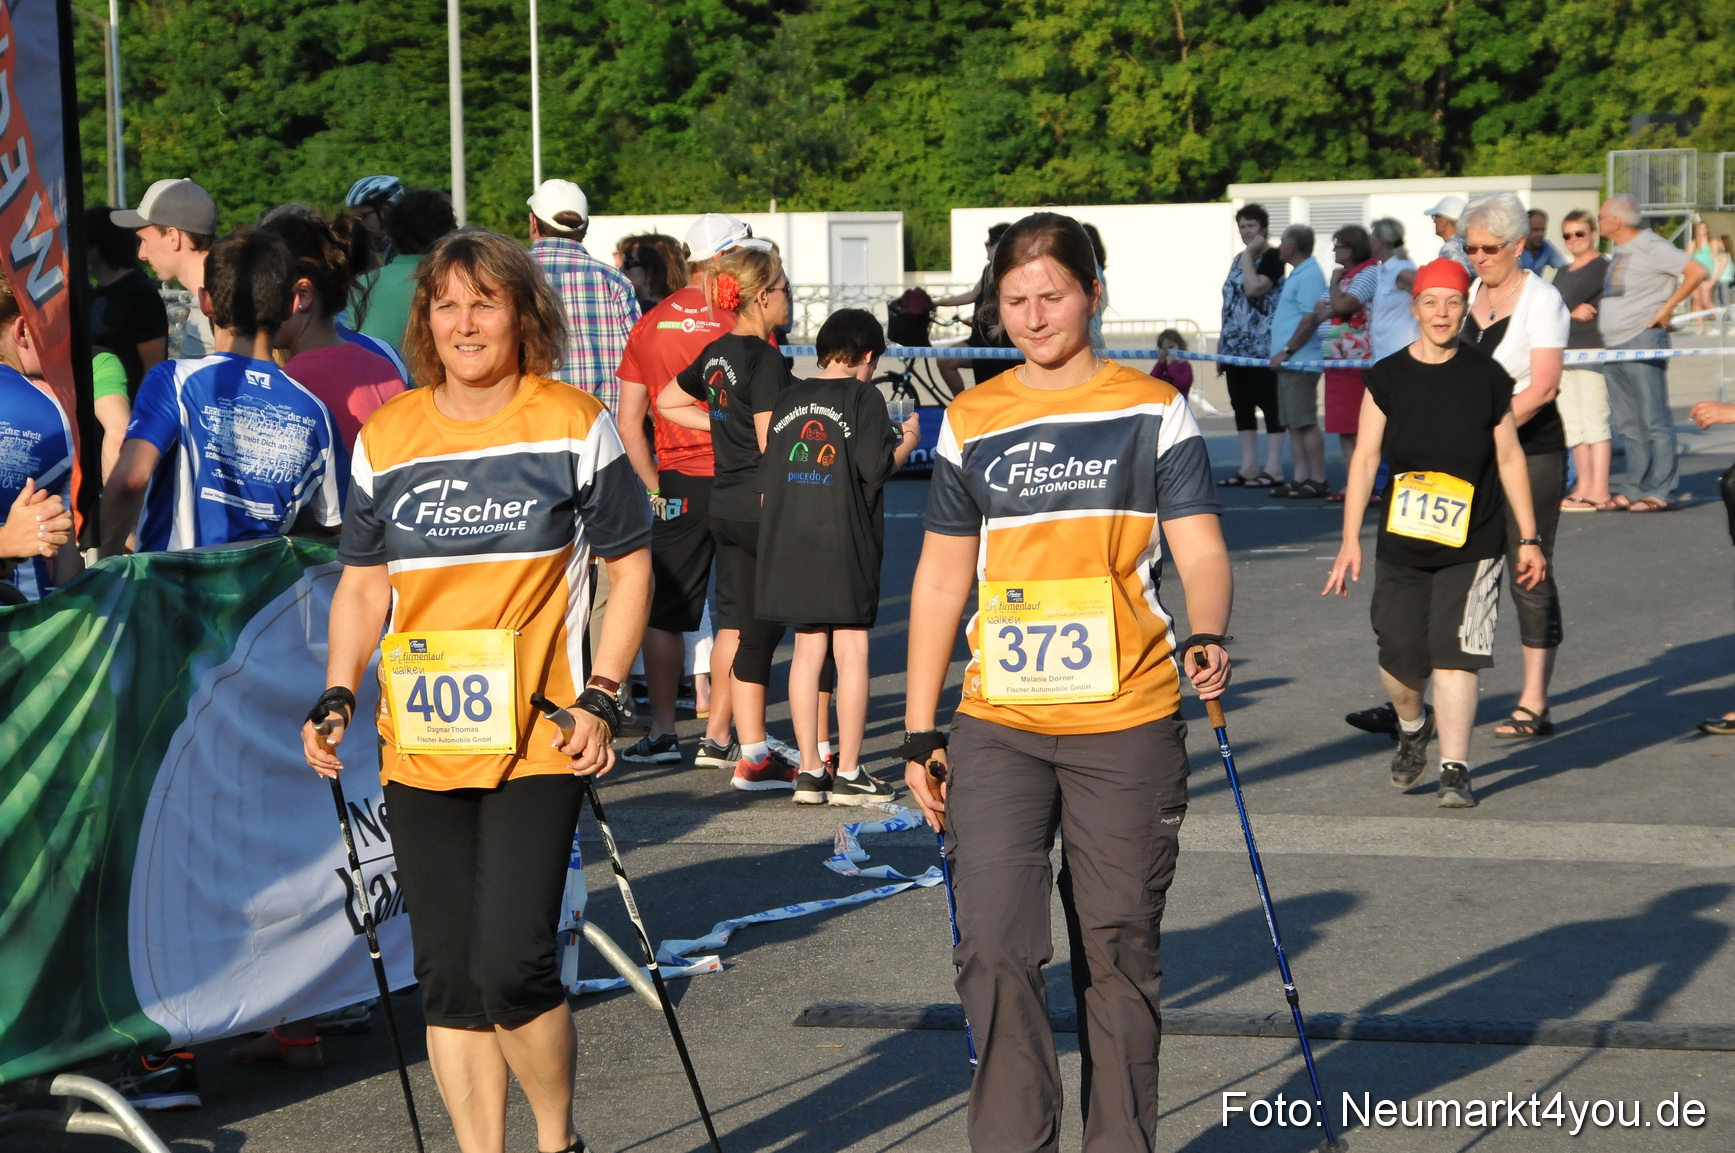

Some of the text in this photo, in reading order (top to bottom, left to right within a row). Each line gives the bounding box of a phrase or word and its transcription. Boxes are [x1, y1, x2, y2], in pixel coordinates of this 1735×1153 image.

[773, 405, 809, 434] Neumarkter
[809, 402, 843, 423] Firmenlauf
[230, 430, 242, 440] Was
[243, 435, 260, 445] treibt
[261, 438, 277, 448] Dich
[278, 443, 292, 451] an?
[1008, 456, 1117, 485] Fischer
[1019, 478, 1108, 498] AUTOMOBILE
[415, 498, 538, 524] Fischer
[1397, 489, 1468, 527] 1157
[425, 520, 527, 537] AUTOMOBILE
[999, 601, 1041, 611] firmenlauf
[402, 651, 444, 661] firmenlauf
[998, 622, 1092, 673] 373
[406, 674, 492, 723] 408
[427, 726, 450, 734] Dagmar
[472, 735, 492, 743] GmbH
